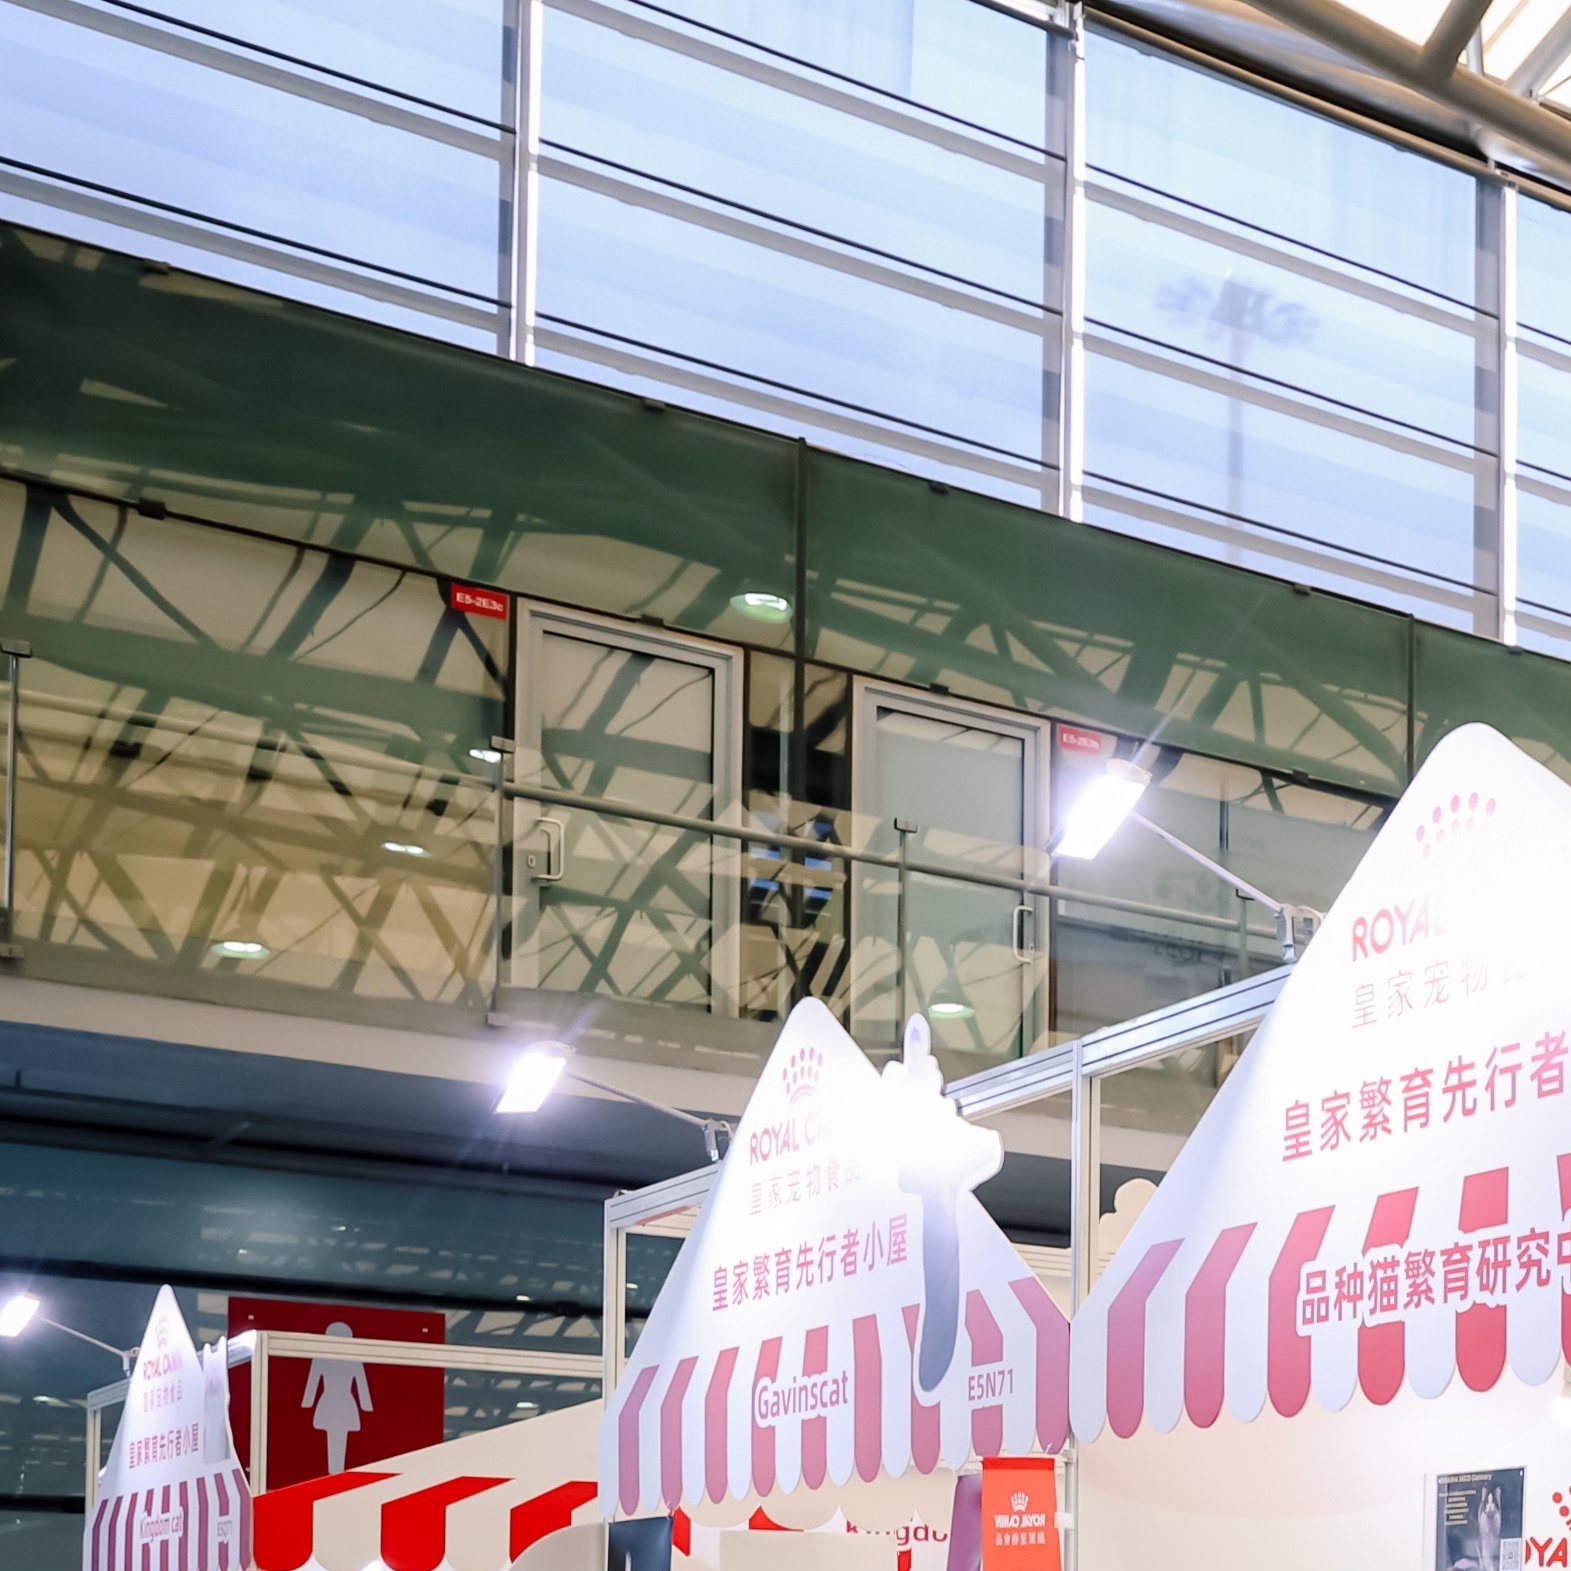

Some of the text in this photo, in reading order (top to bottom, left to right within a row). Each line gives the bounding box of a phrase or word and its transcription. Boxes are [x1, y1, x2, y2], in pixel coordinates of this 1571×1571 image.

[749, 1119, 801, 1166] ROYAL
[711, 1213, 909, 1312] 皇家繁育先行者小屋
[757, 1368, 850, 1421] Gavinscat
[967, 1367, 1015, 1403] E5N71
